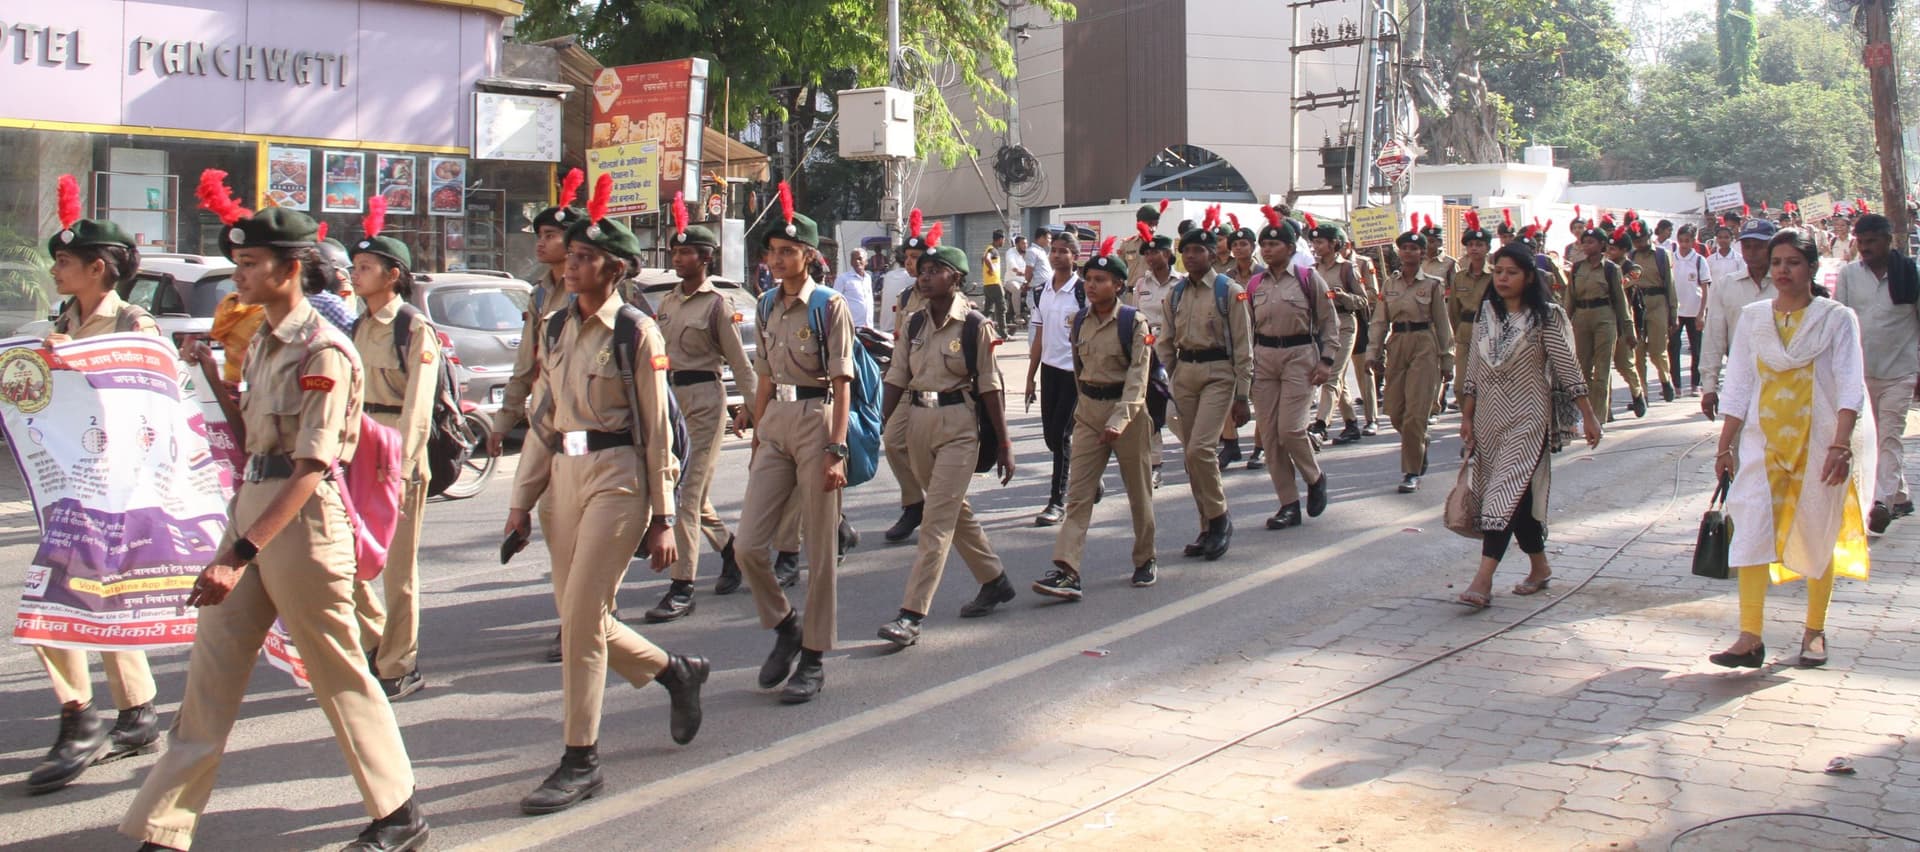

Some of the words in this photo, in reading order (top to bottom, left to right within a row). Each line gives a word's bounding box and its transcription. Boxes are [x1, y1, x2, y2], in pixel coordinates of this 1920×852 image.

[134, 35, 349, 88] PANCHWATI
[305, 378, 331, 390] NCC
[89, 415, 97, 426] 2
[72, 621, 167, 638] पदाधिकारी
